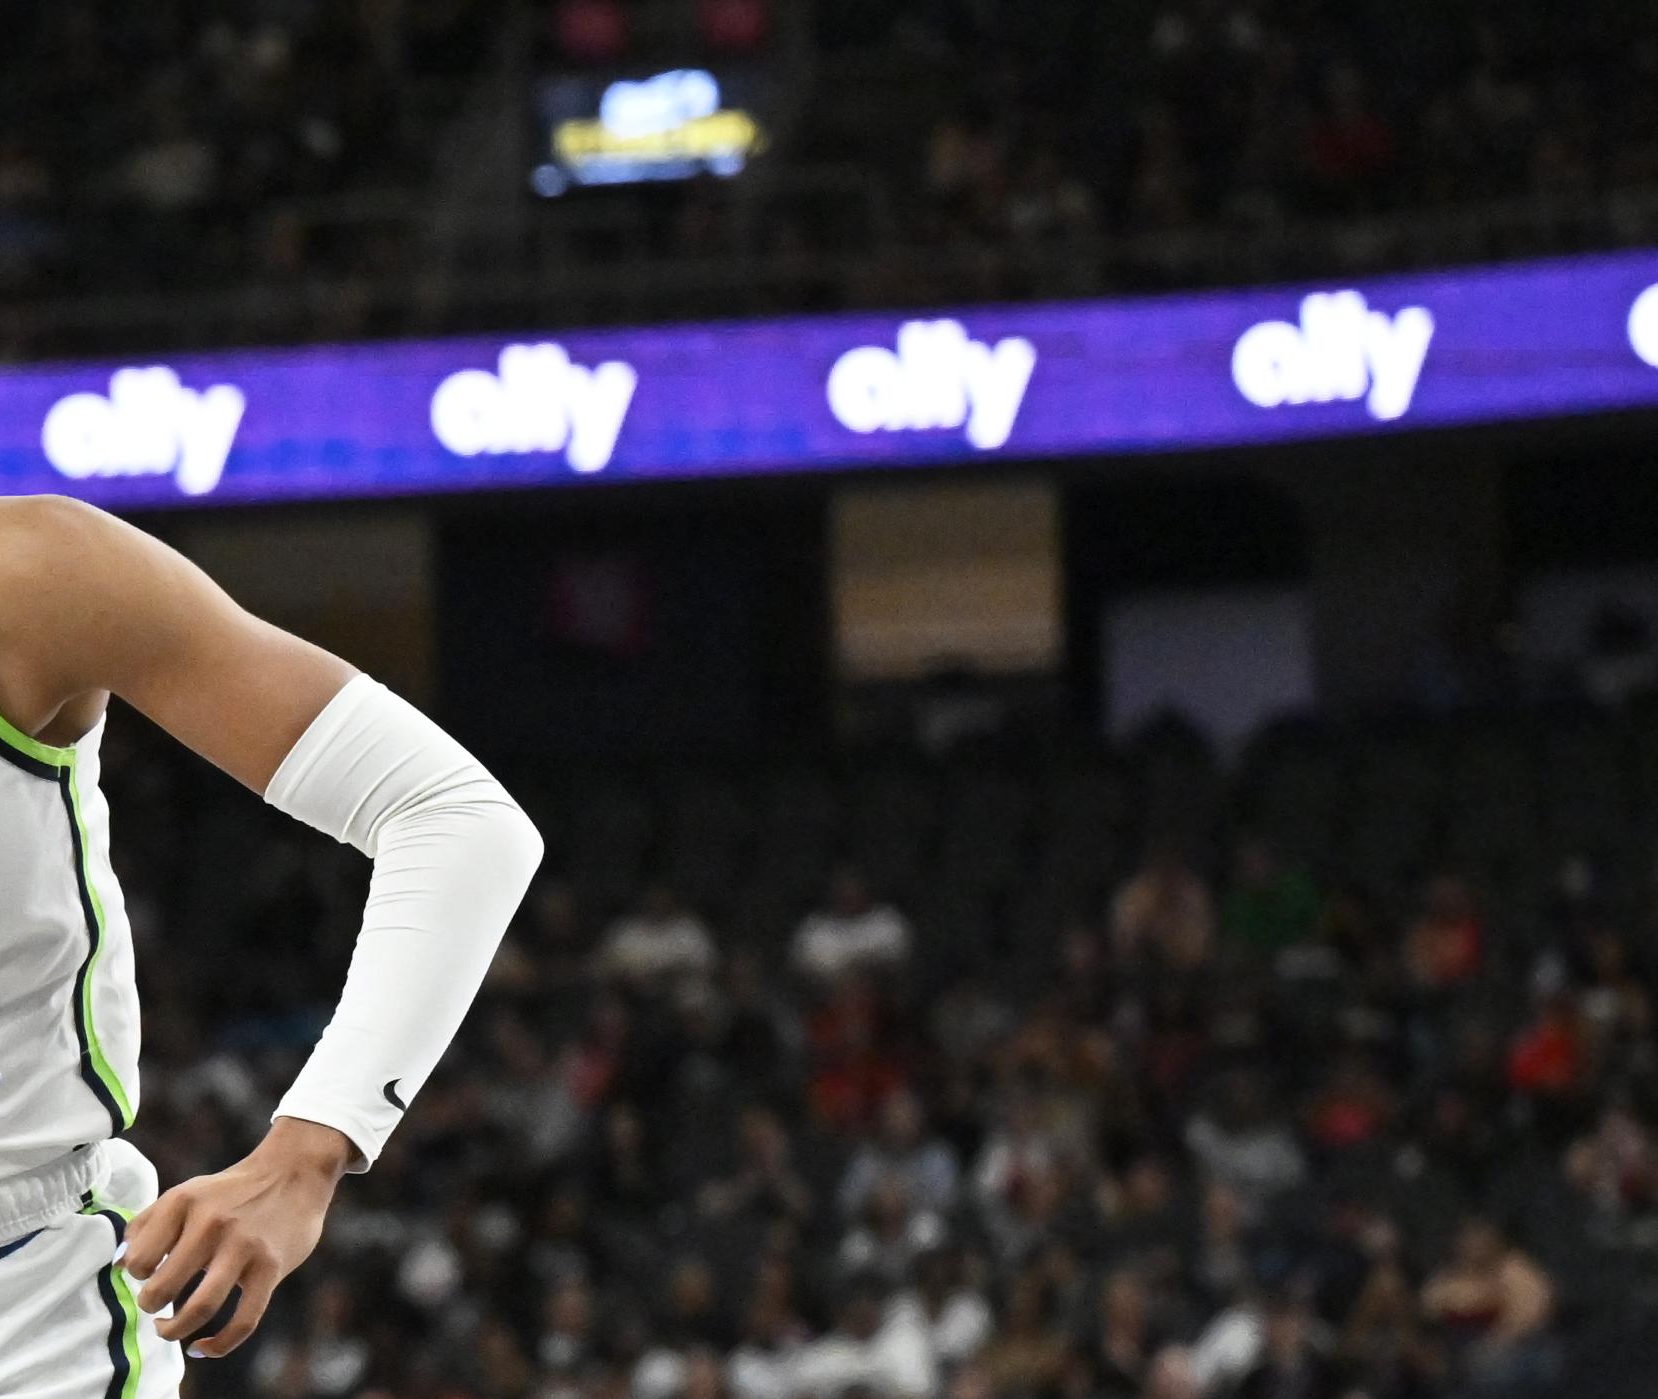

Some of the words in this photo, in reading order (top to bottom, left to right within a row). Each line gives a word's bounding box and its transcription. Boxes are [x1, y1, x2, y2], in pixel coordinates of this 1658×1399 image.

[431, 343, 635, 472] ally
[828, 319, 1035, 449] ally
[1232, 290, 1433, 420] ally
[43, 366, 246, 495] ally
